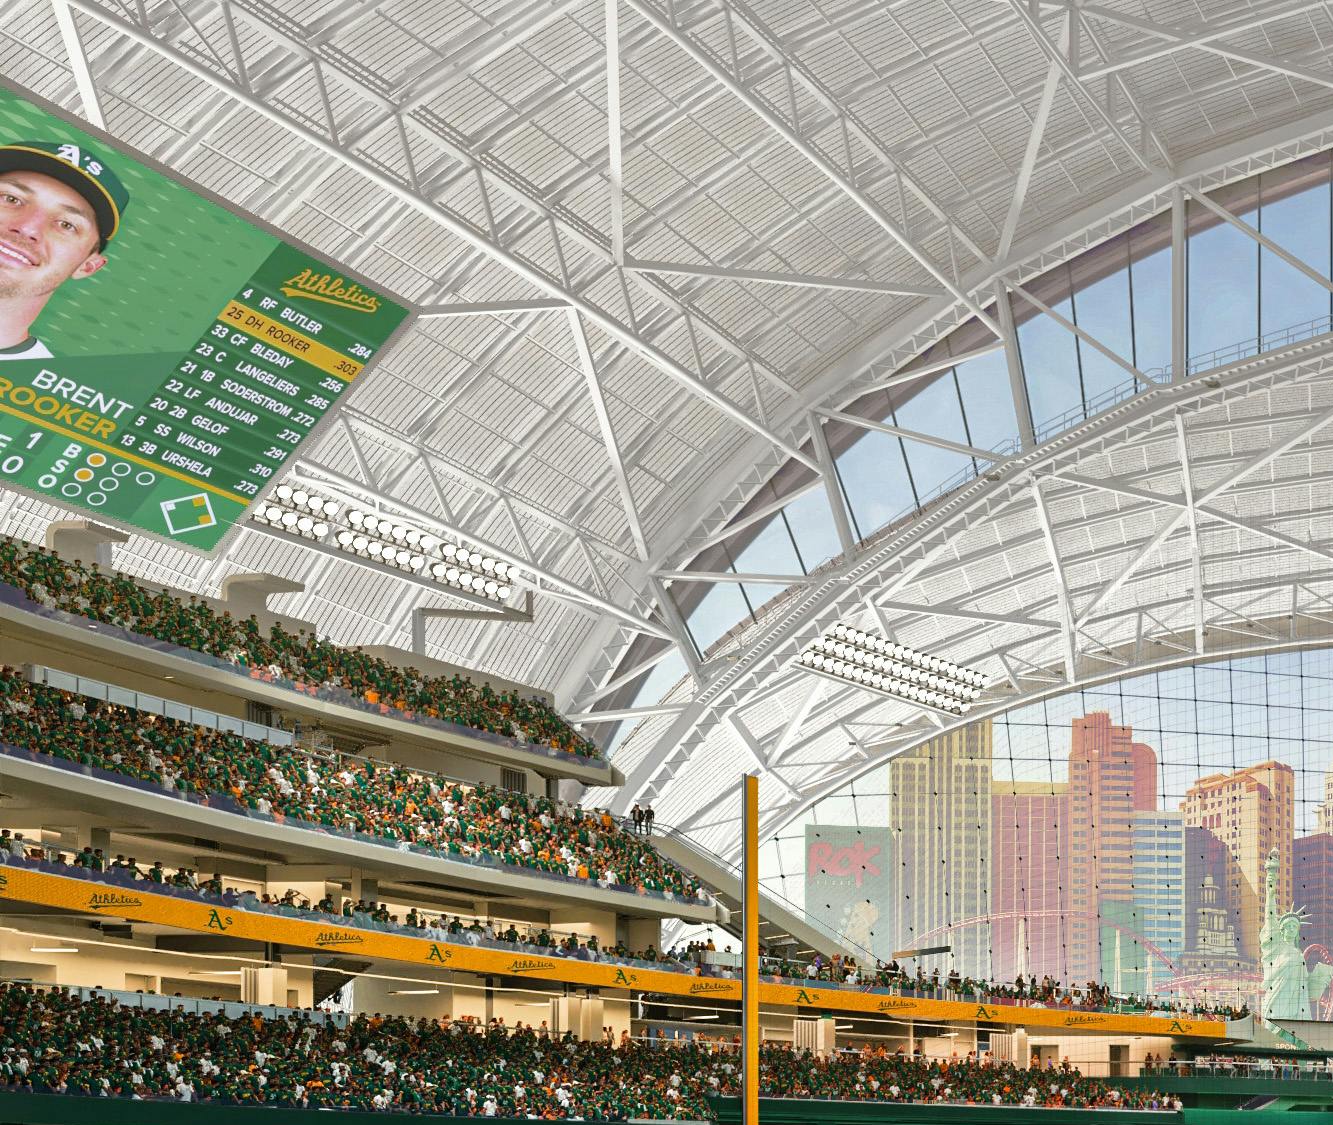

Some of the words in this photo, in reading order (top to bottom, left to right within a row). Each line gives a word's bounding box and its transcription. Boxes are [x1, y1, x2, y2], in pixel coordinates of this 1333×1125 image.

[55, 143, 102, 175] A's
[280, 268, 380, 312] Athletics
[226, 306, 244, 319] 25
[244, 315, 264, 330] DH
[265, 325, 310, 352] ROOKER
[333, 360, 357, 375] .303
[242, 288, 253, 298] 4
[259, 296, 278, 309] RF
[280, 307, 322, 334] BUTLER
[347, 343, 371, 359] .284
[195, 342, 213, 356] 23
[215, 351, 226, 362] C
[235, 360, 299, 396] LANGELIERS
[304, 394, 329, 409] .285
[211, 324, 228, 338] 33
[230, 333, 248, 345] CF
[250, 343, 293, 368] BLEDAY
[318, 377, 343, 392] .256
[31, 369, 133, 418] BRENT
[164, 379, 183, 393] 22
[183, 387, 201, 399] LF
[204, 397, 258, 425] ANDUJAR
[276, 429, 300, 443] .273
[180, 361, 197, 374] 21
[200, 369, 215, 382] 1B
[220, 379, 292, 416] SODERSTROM
[290, 411, 314, 427] .272
[26, 432, 42, 449] 1
[62, 443, 81, 458] B
[135, 415, 147, 426] 5
[153, 423, 171, 436] SS
[176, 431, 221, 456] WILSON
[248, 463, 272, 477] .310
[149, 397, 168, 410] 20
[168, 405, 187, 418] 2B
[191, 415, 229, 435] GELOF
[263, 446, 287, 460] .291
[1, 455, 23, 473] 0
[50, 459, 69, 473] S
[120, 434, 135, 446] 13
[138, 441, 157, 454] 3B
[161, 450, 212, 477] URSHELA
[233, 480, 258, 494] .273
